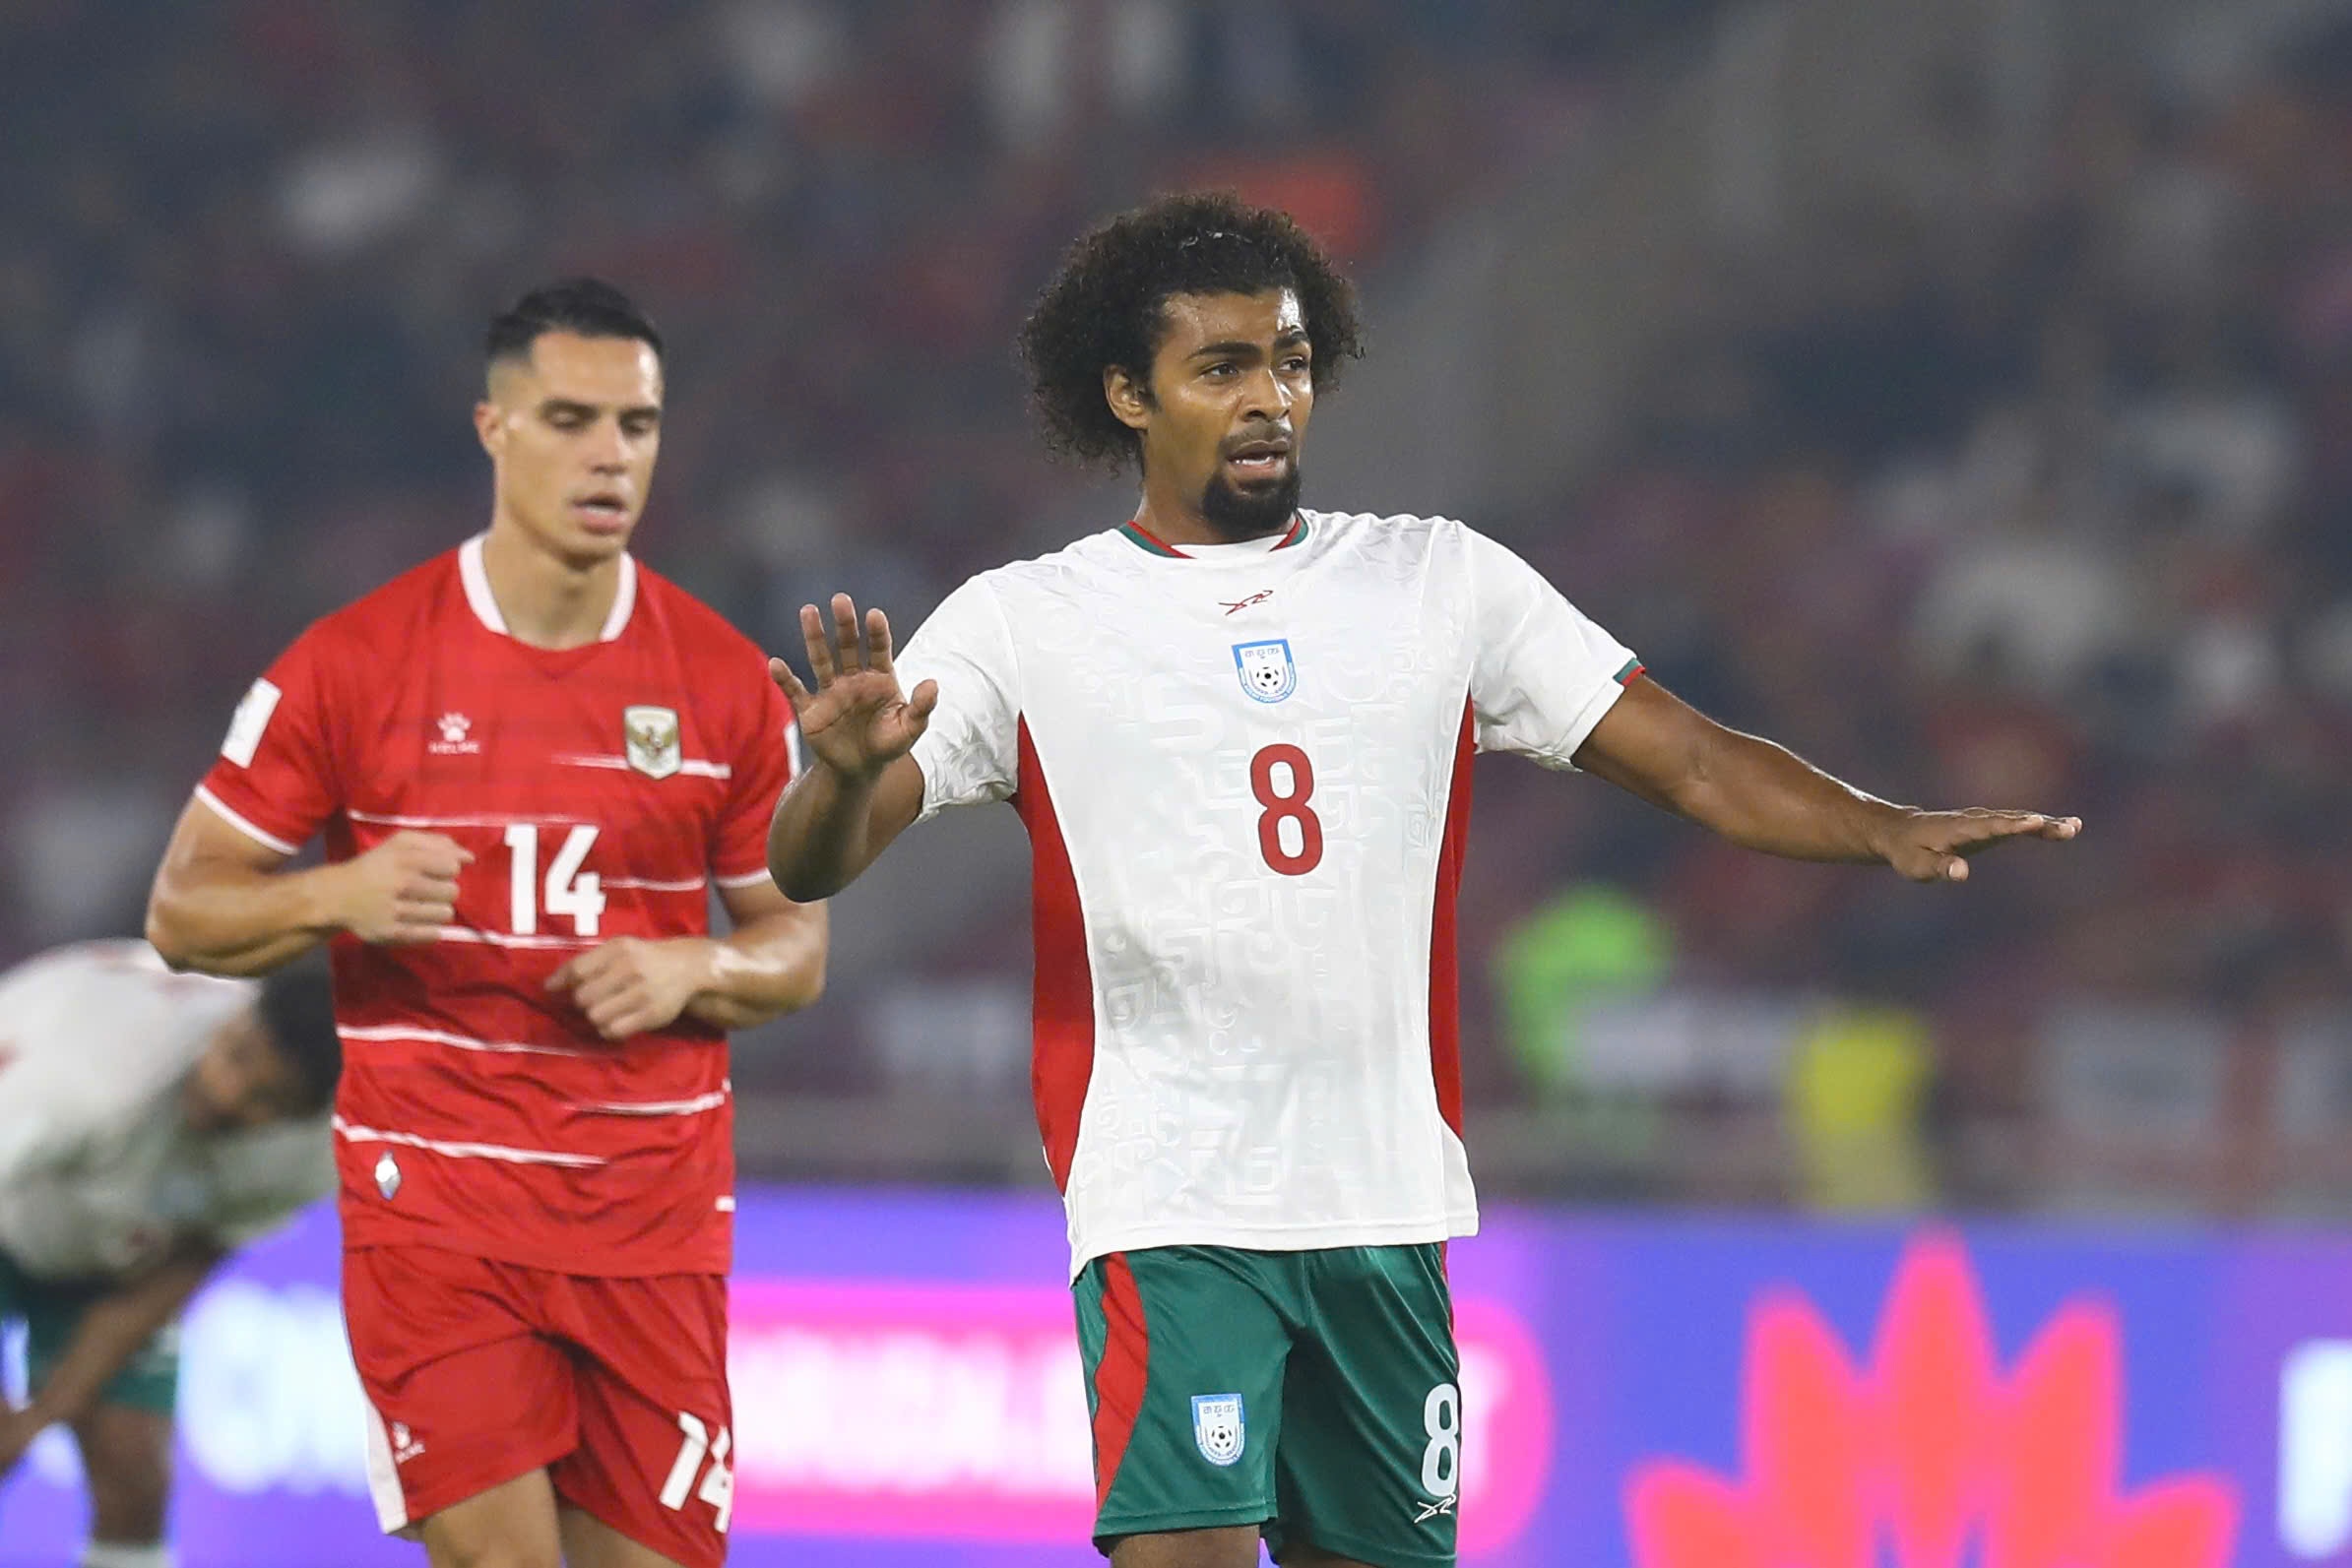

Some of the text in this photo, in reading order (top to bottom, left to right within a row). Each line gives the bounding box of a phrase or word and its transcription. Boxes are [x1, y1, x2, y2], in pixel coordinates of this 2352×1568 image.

[1249, 743, 1323, 876] 8
[504, 824, 607, 937] 14
[659, 1410, 733, 1534] 14
[1422, 1383, 1458, 1497] 8
